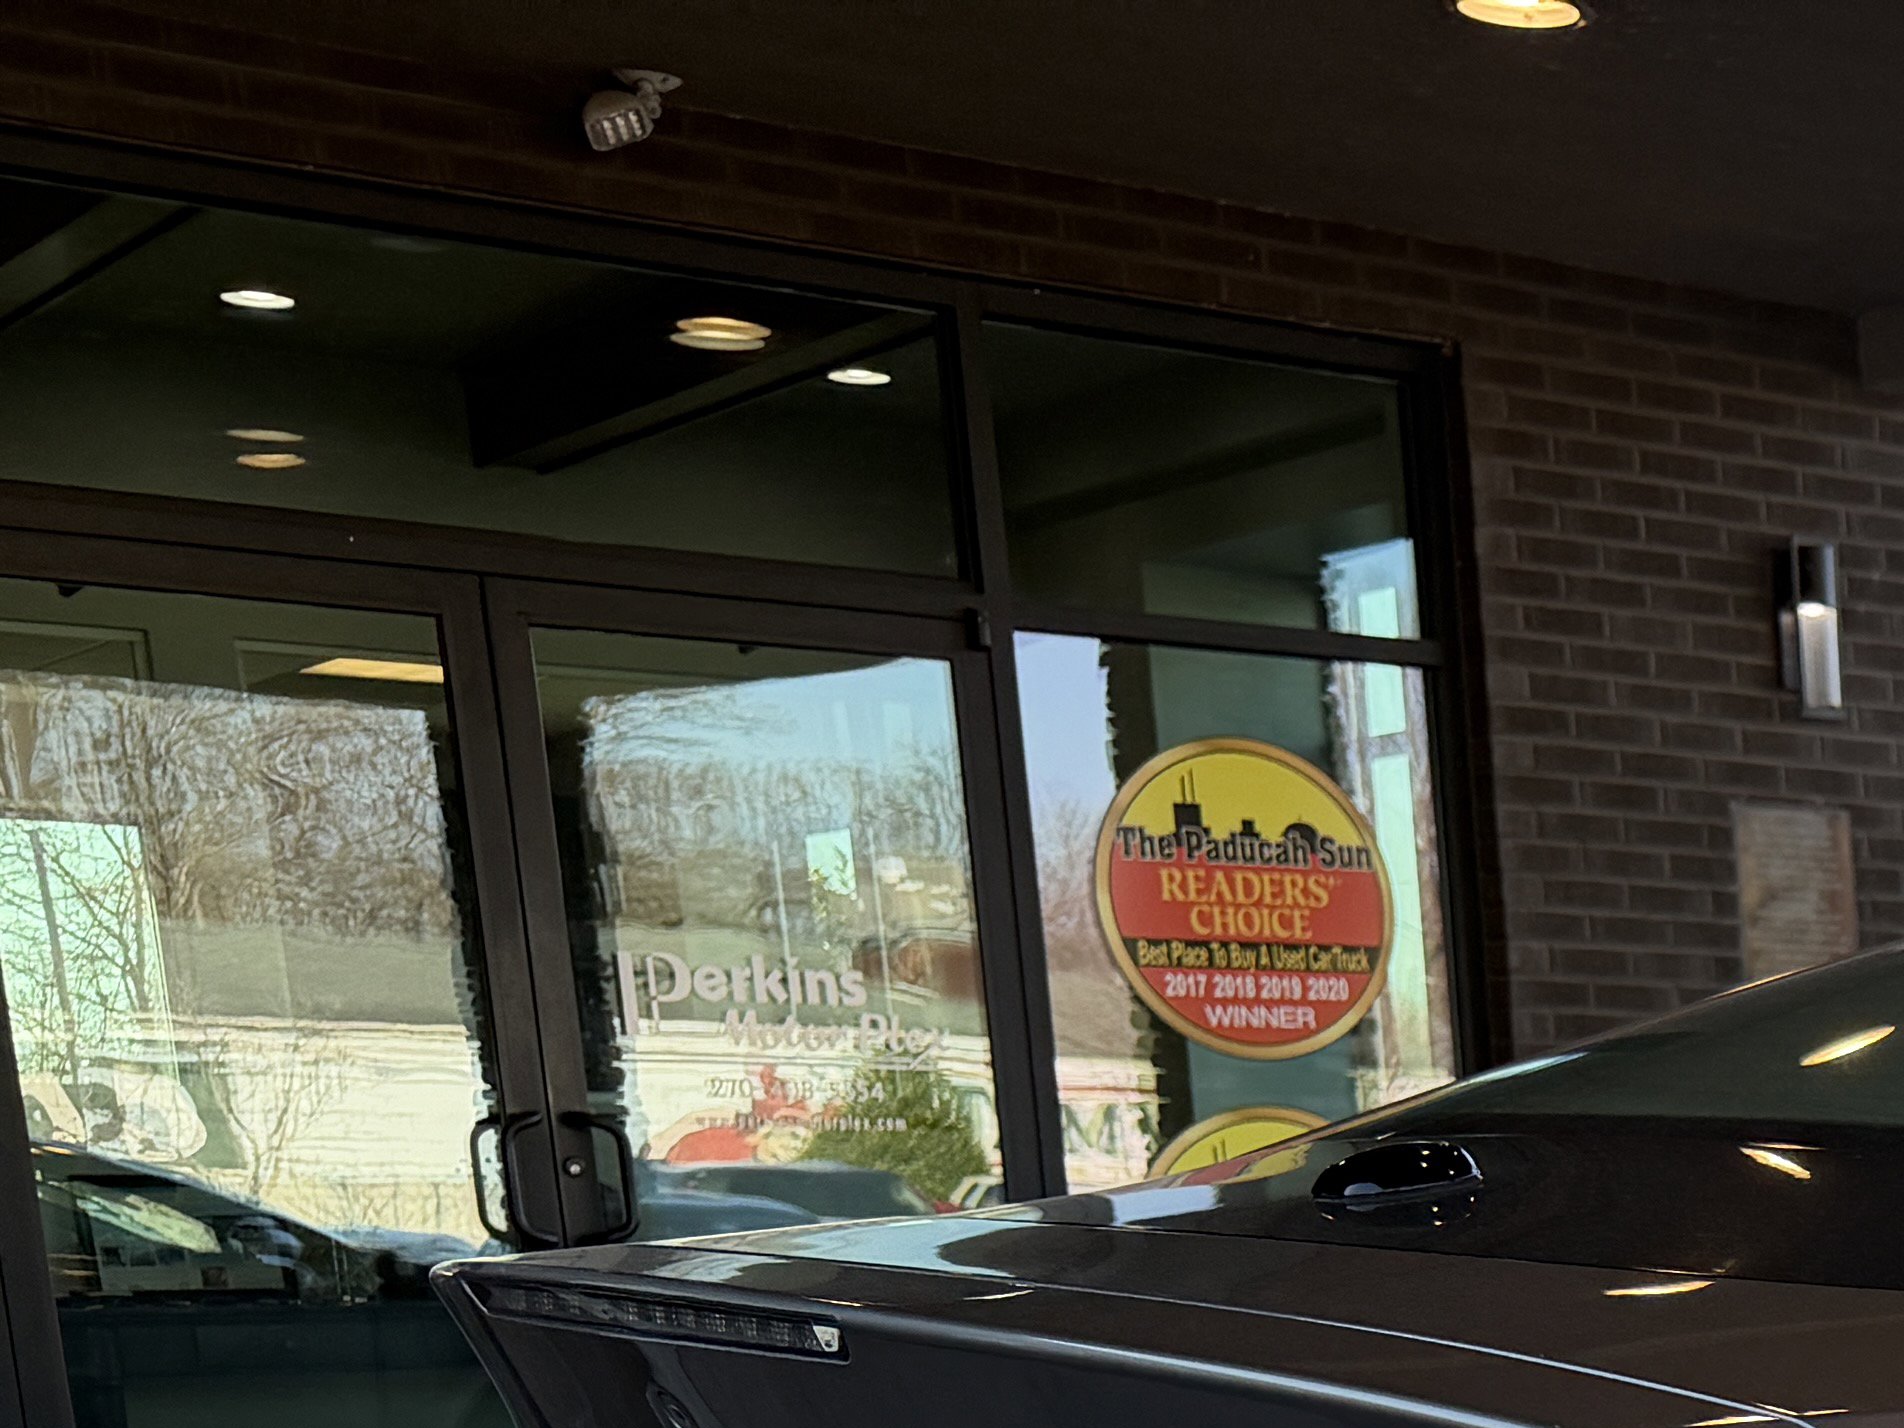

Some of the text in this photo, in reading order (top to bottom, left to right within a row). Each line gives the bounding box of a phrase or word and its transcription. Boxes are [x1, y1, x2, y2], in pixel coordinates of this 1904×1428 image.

[1115, 824, 1374, 872] The Paducah Sun
[1190, 905, 1312, 940] CHOICE
[1136, 939, 1169, 967] Best
[1170, 940, 1210, 968] Place
[1210, 942, 1228, 969] To
[1230, 942, 1257, 973] Buy
[1259, 944, 1271, 970] A
[1272, 944, 1306, 971] Used
[617, 950, 869, 1036] Perkins
[1164, 972, 1350, 1002] 2017 2018 2019 2020
[1204, 1003, 1317, 1031] WINNER
